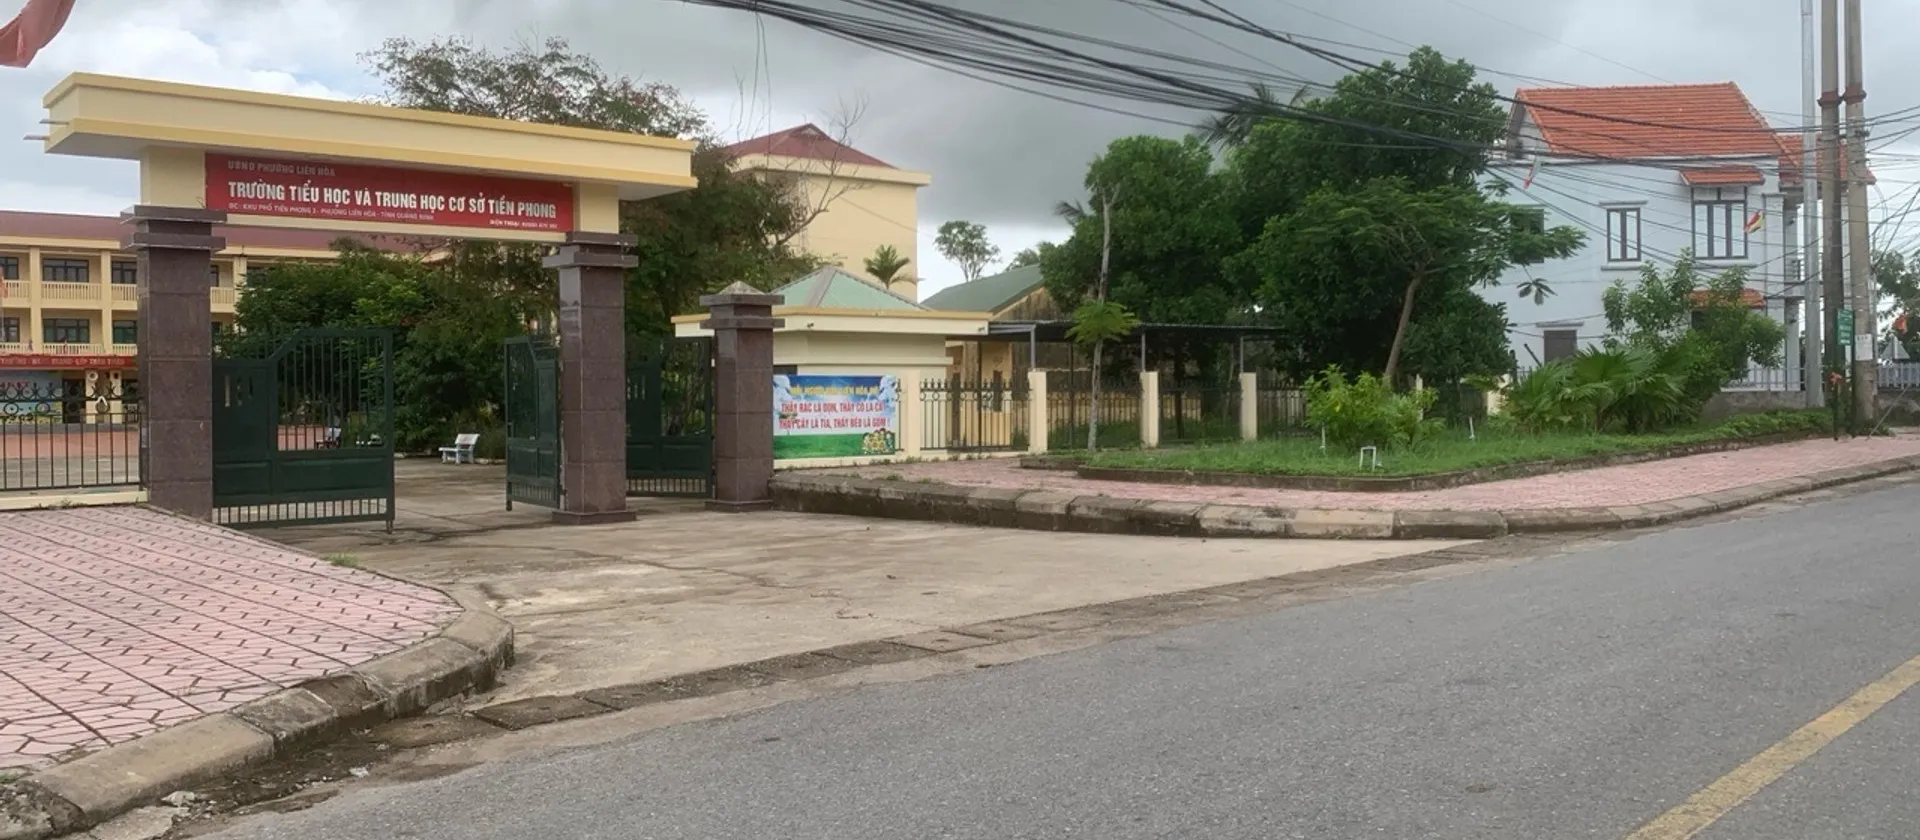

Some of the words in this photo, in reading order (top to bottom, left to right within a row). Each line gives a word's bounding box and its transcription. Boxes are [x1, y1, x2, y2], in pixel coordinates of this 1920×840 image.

[228, 179, 285, 201] TRƯỜNG
[289, 179, 320, 203] TIỂU
[323, 187, 350, 208] HỌC
[355, 187, 372, 206] VÀ
[375, 191, 417, 209] TRUNG
[420, 194, 445, 213] HỌC
[448, 196, 466, 212] CƠ
[469, 192, 486, 213] SỞ
[518, 202, 557, 218] PHONG
[781, 401, 797, 413] THẤY
[840, 401, 855, 413] THẤY
